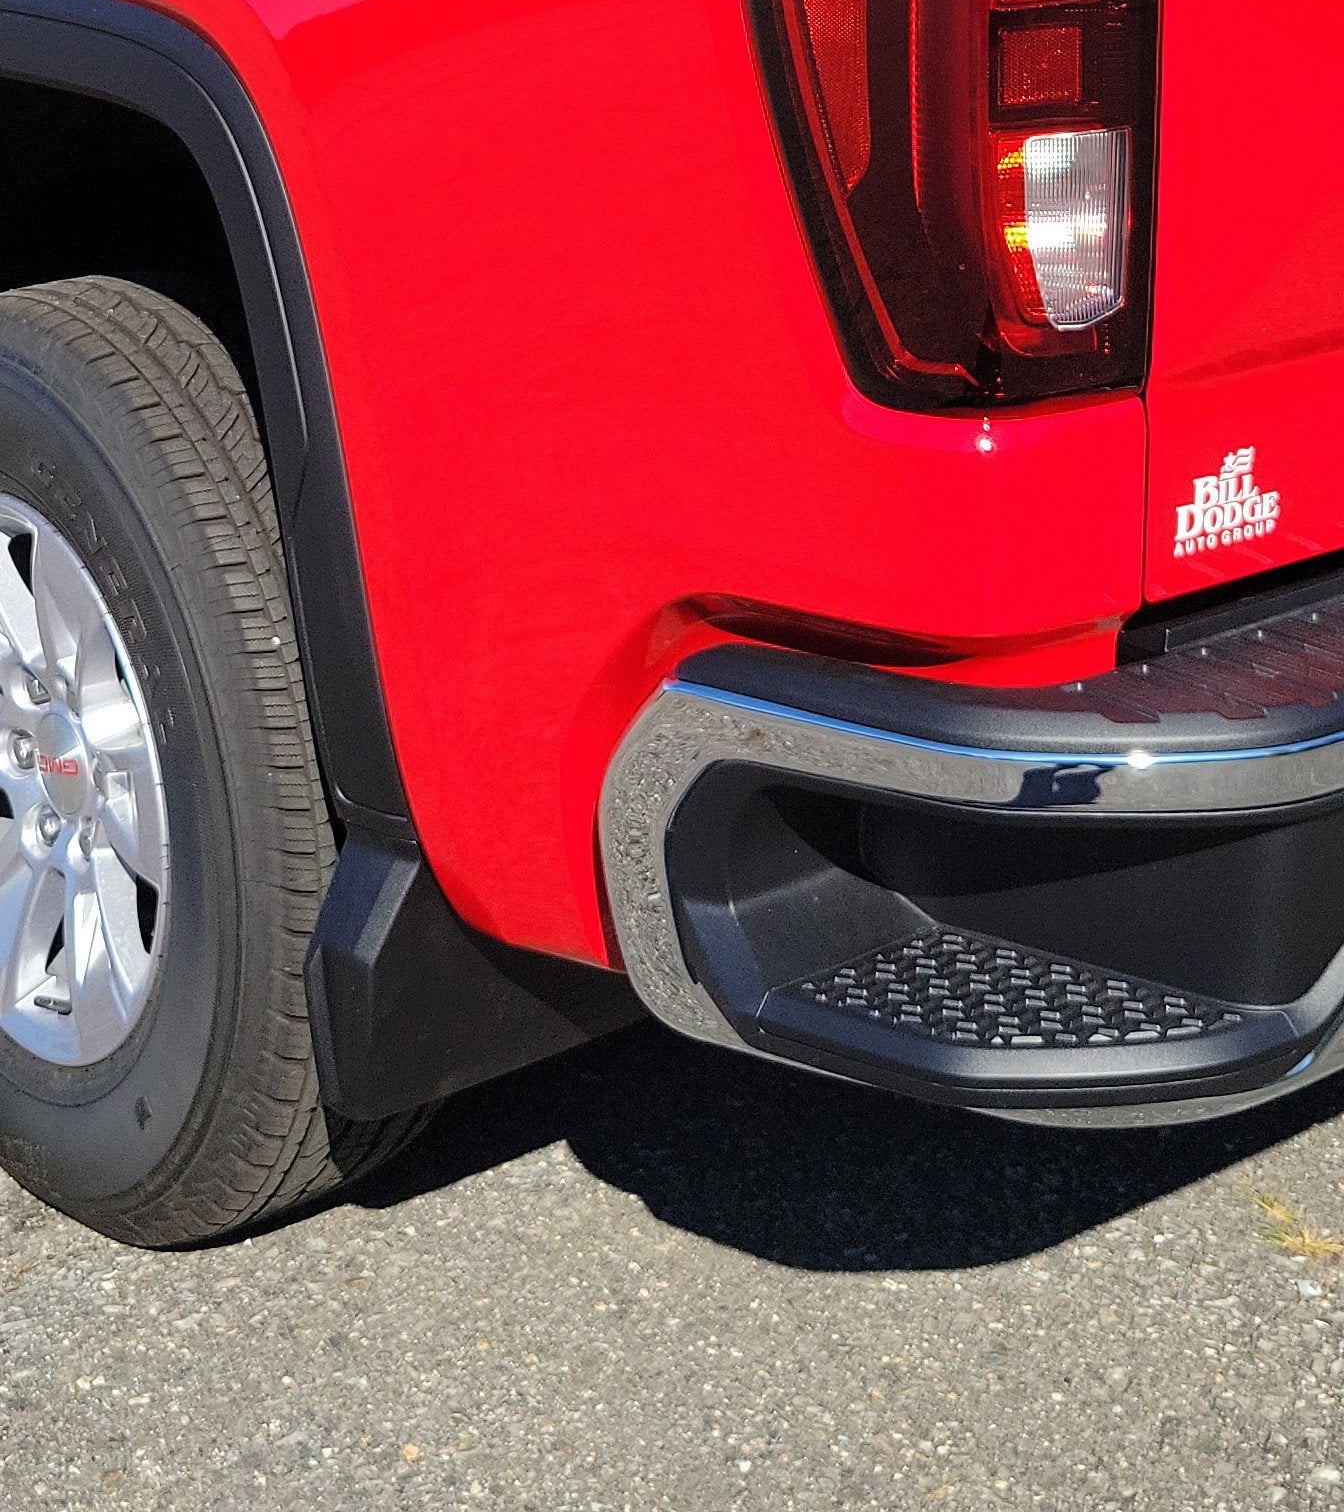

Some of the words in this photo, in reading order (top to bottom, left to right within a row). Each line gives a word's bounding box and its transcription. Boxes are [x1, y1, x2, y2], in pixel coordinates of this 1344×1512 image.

[1194, 474, 1259, 507] BILL
[1176, 491, 1280, 540] DODGE
[1174, 534, 1218, 558] AUTO
[1222, 520, 1275, 546] GROUP
[38, 752, 80, 778] GMC
